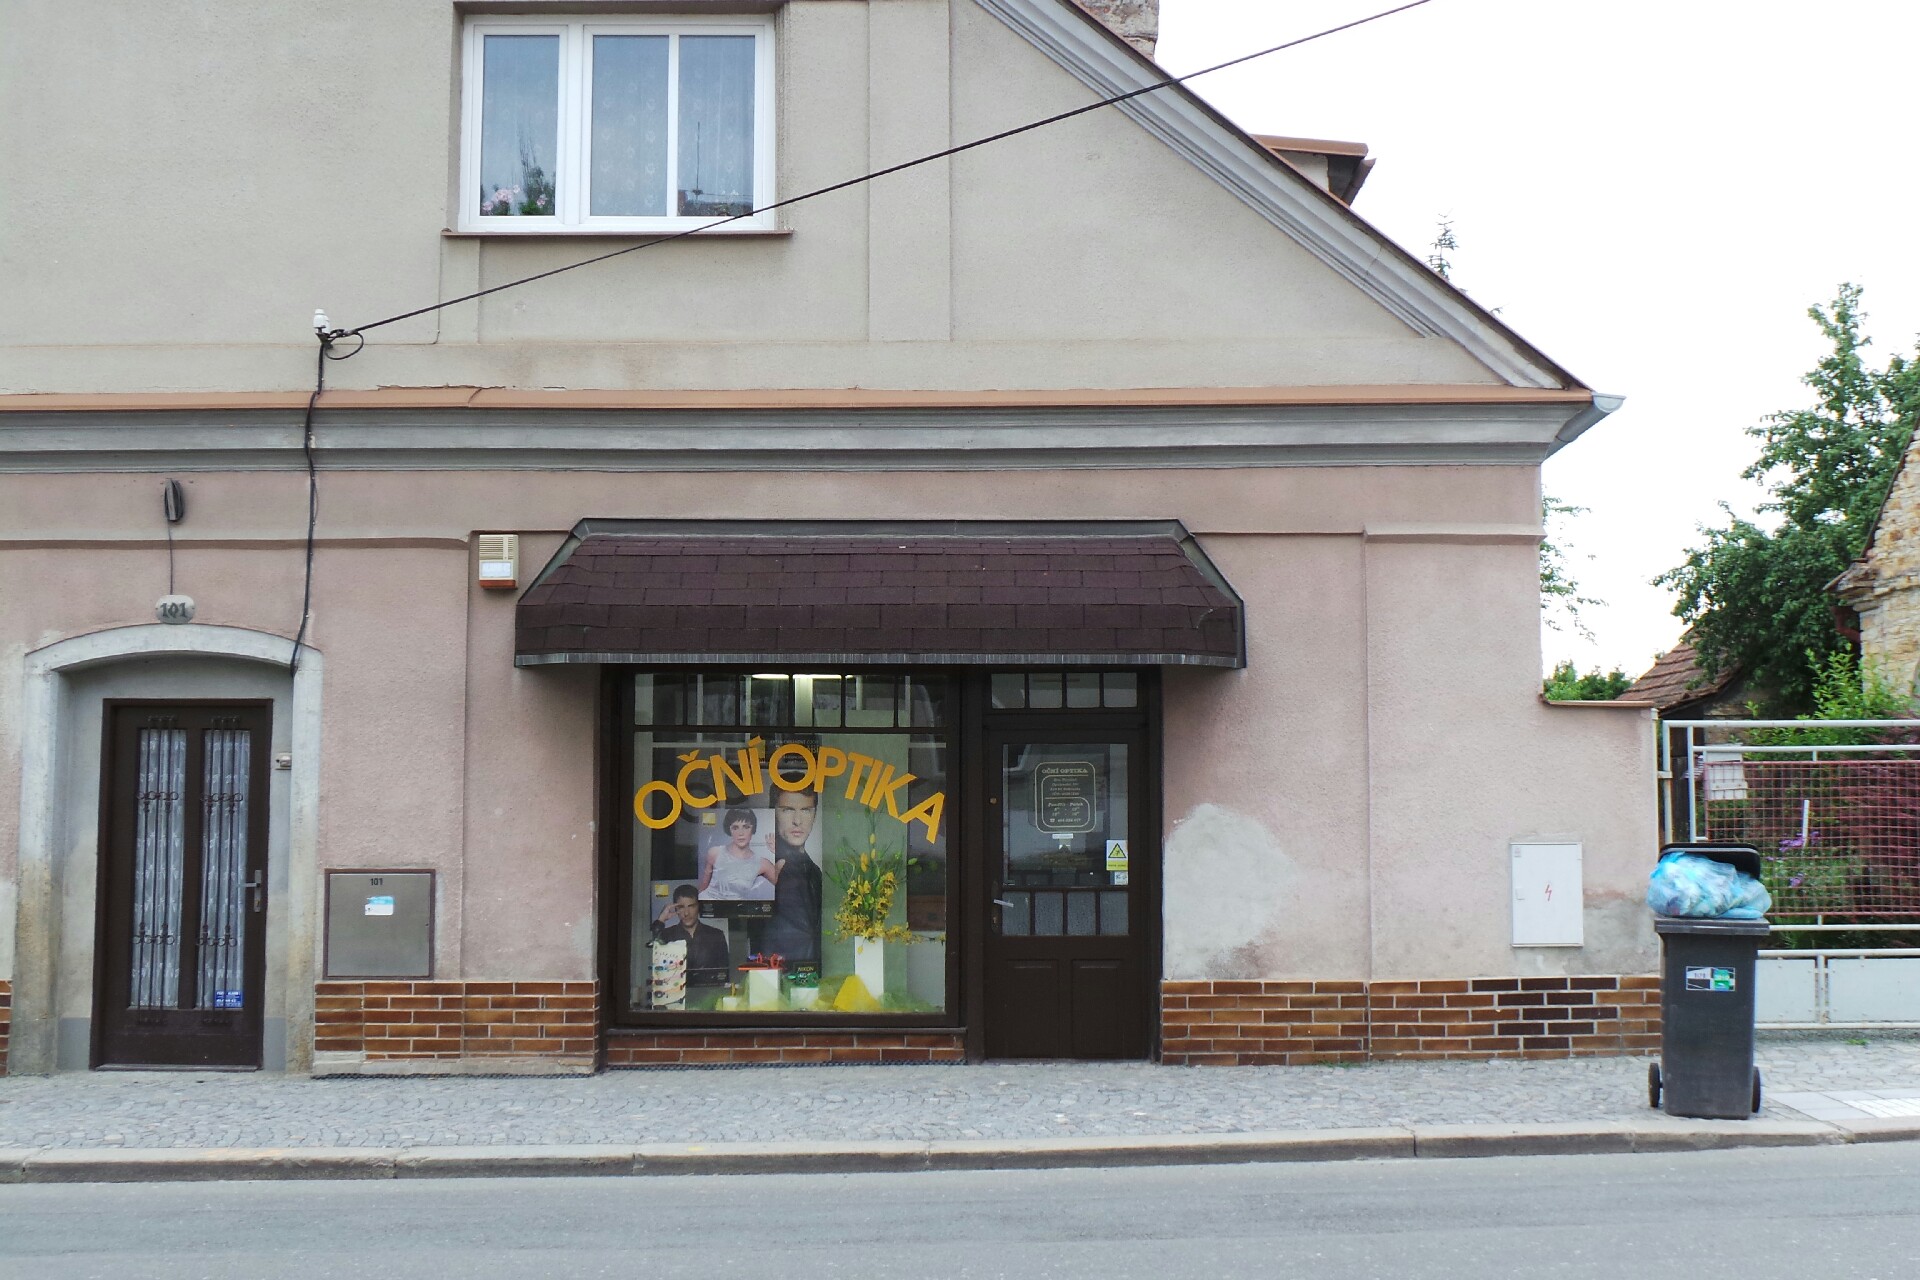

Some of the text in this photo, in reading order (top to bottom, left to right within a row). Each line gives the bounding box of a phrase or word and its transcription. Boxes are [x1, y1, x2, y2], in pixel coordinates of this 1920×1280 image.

[160, 602, 188, 618] 101
[634, 735, 945, 844] OČNÍ OPTIKA
[370, 877, 383, 886] 101
